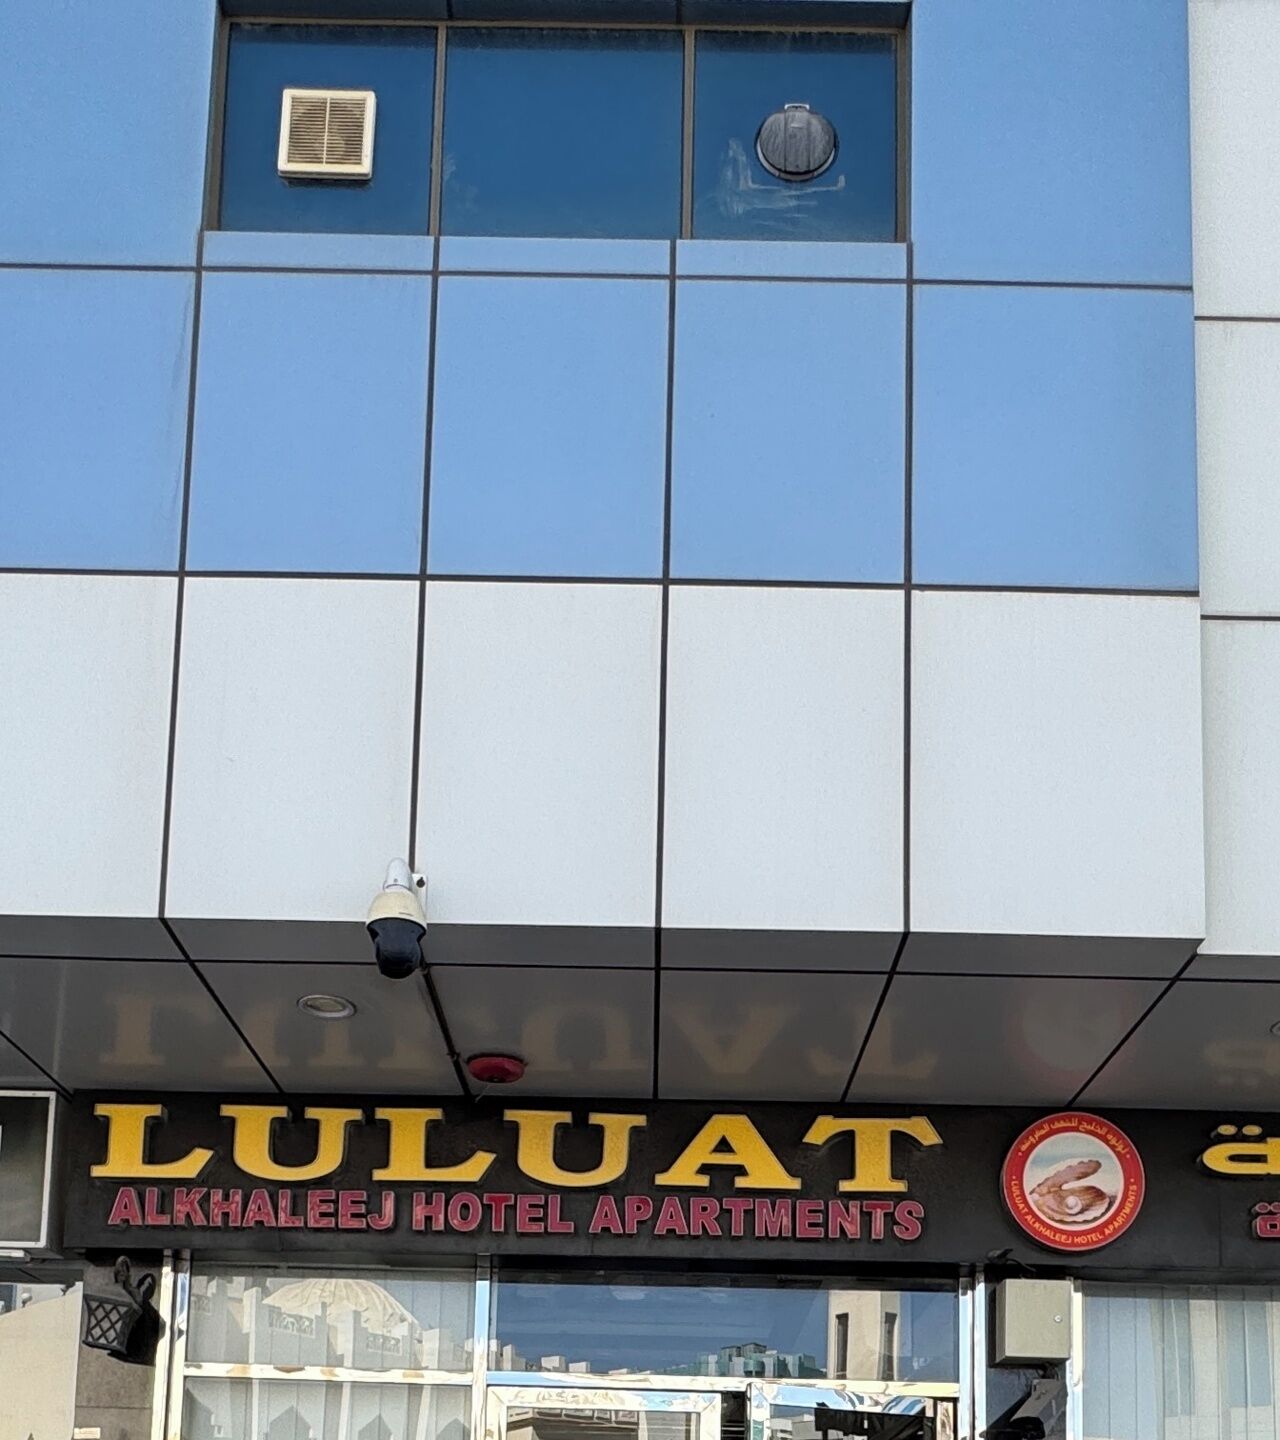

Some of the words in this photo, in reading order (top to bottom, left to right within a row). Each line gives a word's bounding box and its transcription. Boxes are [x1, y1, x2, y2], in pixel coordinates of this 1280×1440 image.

[89, 1102, 944, 1193] LULUAT
[108, 1187, 398, 1231] ALKHALEEJ
[413, 1191, 574, 1235] HOTEL
[589, 1194, 926, 1241] APARTMENTS
[1010, 1180, 1028, 1215] LULUAT
[1024, 1211, 1072, 1244] ALKHALEEJ
[1074, 1232, 1104, 1244] HOTEL
[1104, 1184, 1138, 1236] APARTMENTS
